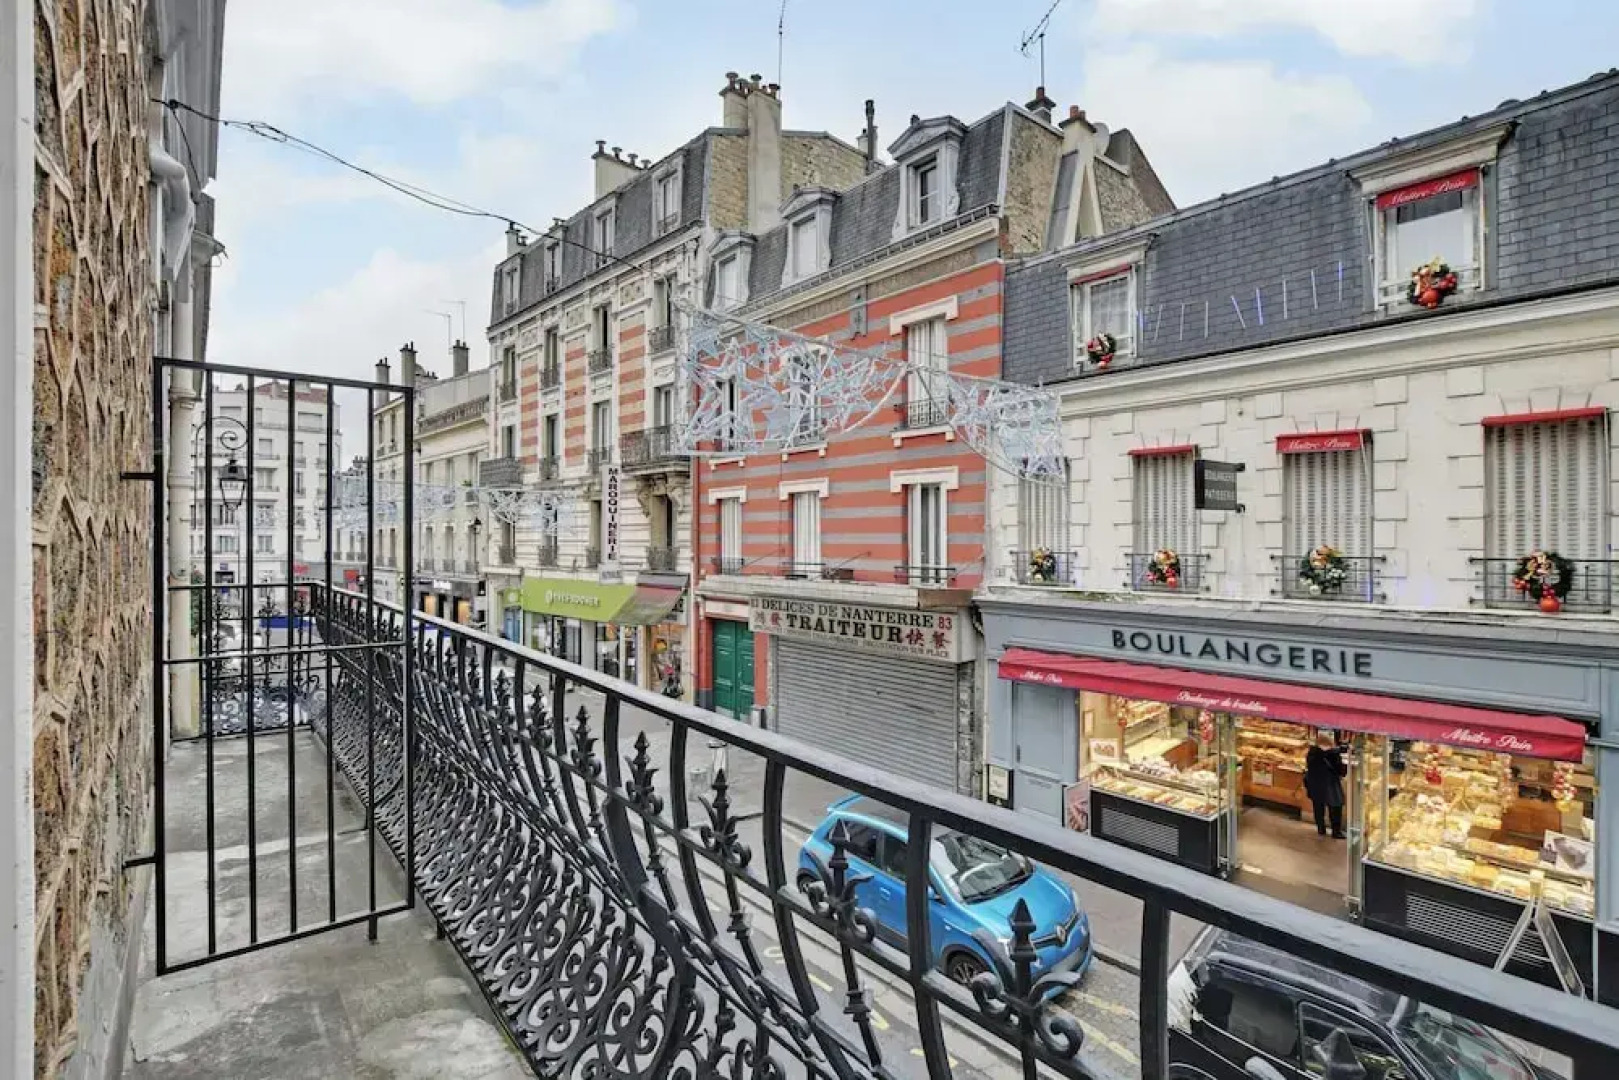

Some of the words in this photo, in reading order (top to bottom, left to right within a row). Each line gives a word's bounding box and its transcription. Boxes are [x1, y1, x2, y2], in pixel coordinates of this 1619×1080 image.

[608, 467, 618, 560] MAROQUINERIE
[762, 599, 815, 614] DELICES
[819, 605, 837, 617] DE
[841, 607, 933, 628] NANTERRE
[938, 616, 953, 630] 83
[787, 613, 903, 643] TRAITEUR
[1112, 629, 1372, 677] BOULANGERIE
[1220, 697, 1231, 706] de
[1496, 735, 1533, 750] Pain
